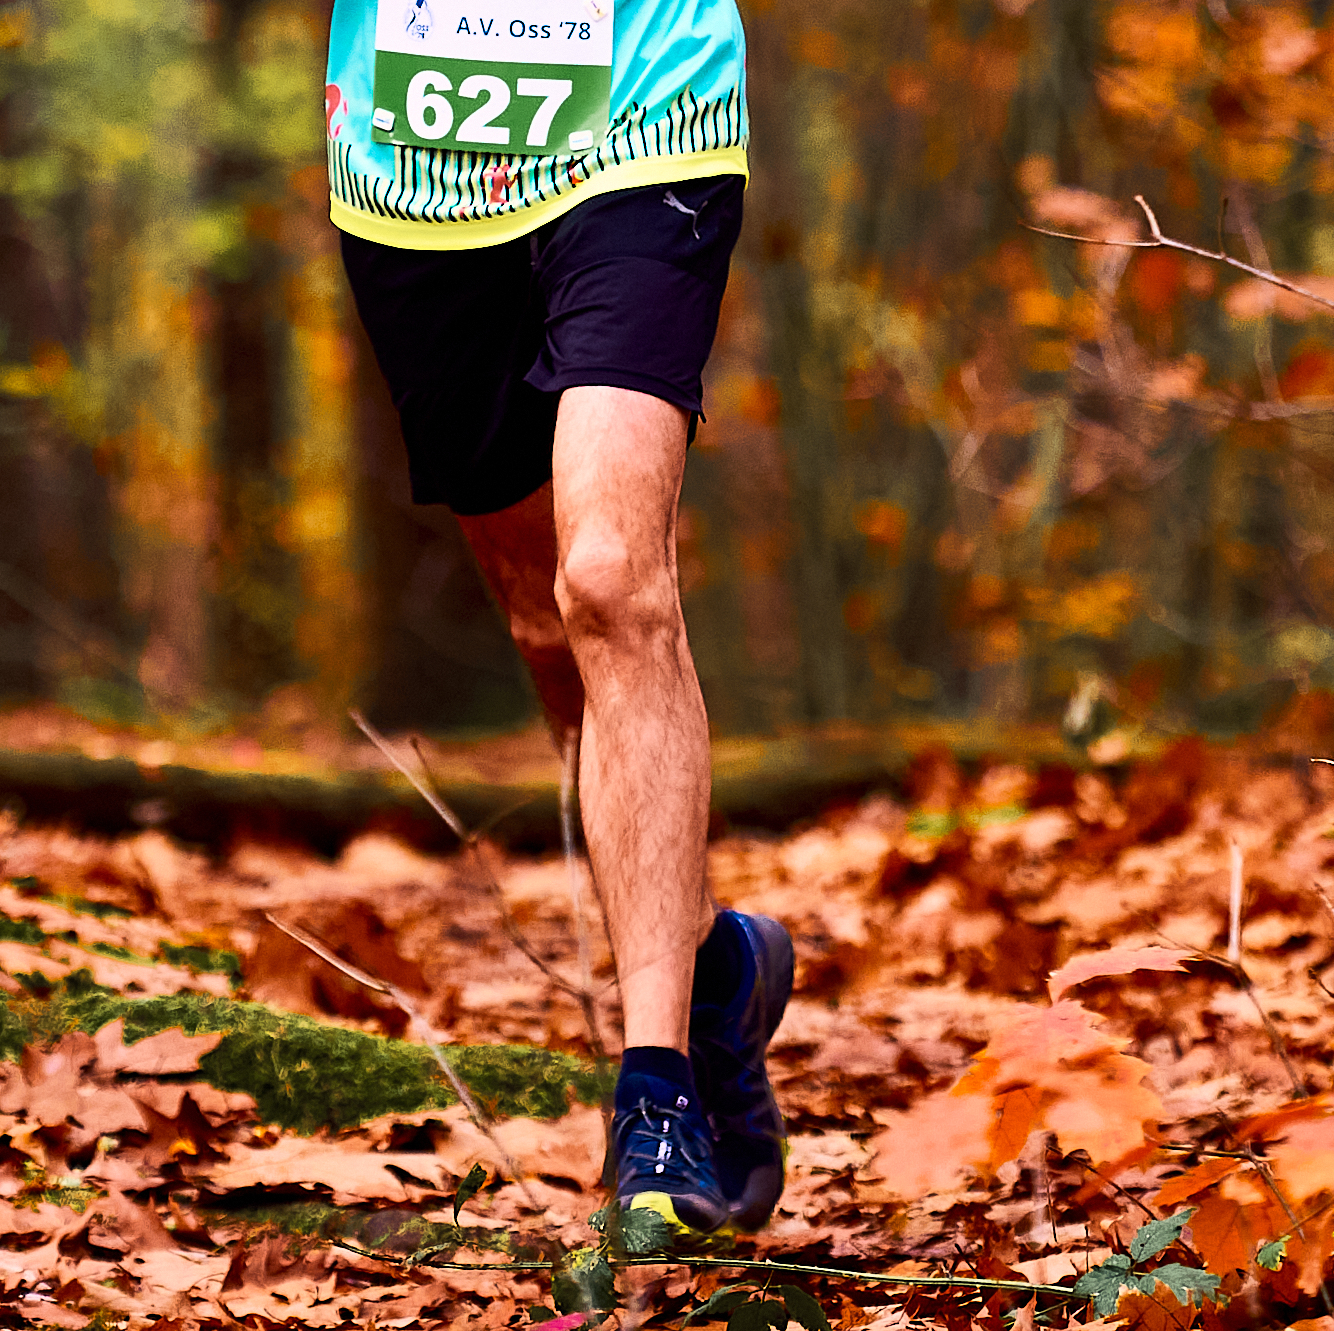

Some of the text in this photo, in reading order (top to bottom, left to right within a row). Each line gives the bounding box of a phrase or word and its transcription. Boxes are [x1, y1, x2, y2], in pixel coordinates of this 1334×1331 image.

[456, 16, 500, 37] A.V.
[509, 19, 551, 39] Oss
[406, 70, 573, 147] 627
